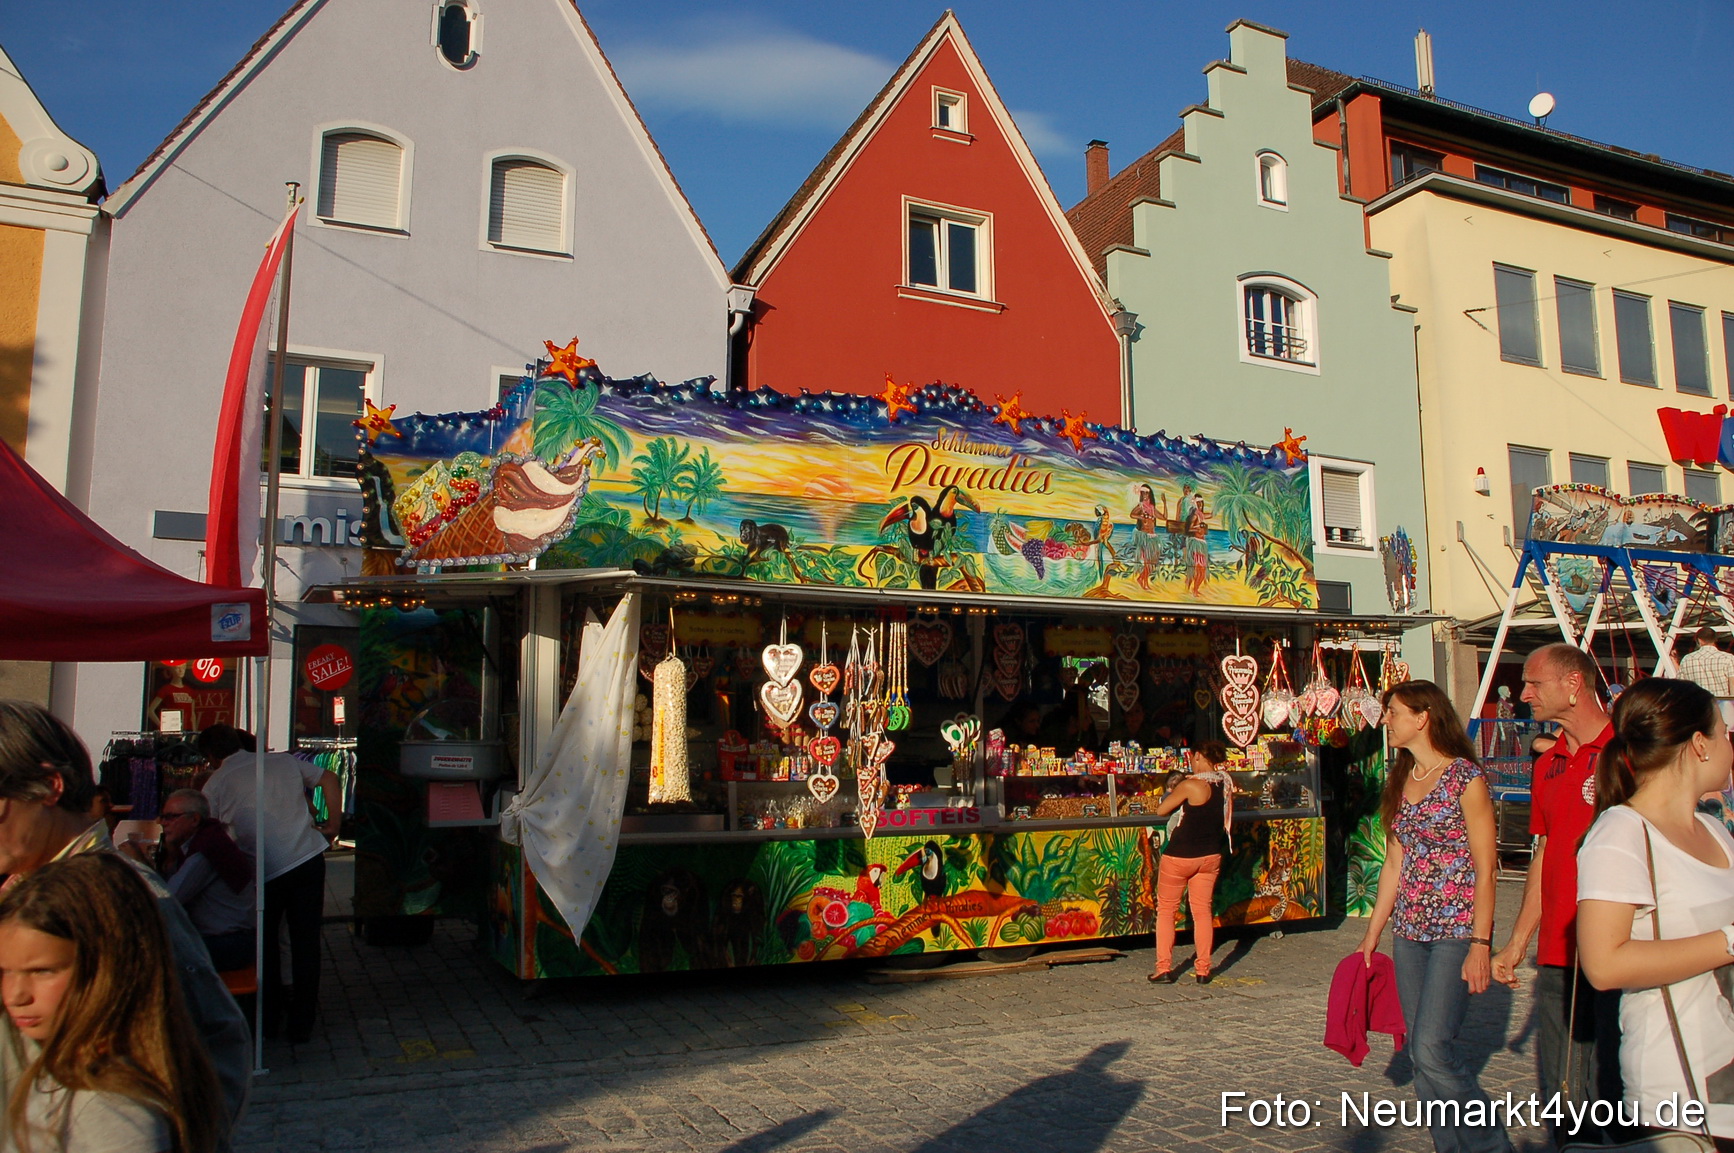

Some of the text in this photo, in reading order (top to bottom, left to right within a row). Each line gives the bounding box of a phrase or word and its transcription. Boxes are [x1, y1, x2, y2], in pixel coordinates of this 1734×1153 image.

[930, 427, 1013, 458] Schlemmer
[885, 442, 1055, 496] Paradies
[307, 652, 336, 670] FREAKY
[311, 656, 350, 683] SALE!
[876, 806, 981, 828] SOFTEIS
[944, 900, 983, 914] Paradies
[873, 913, 933, 951] Schlemmer
